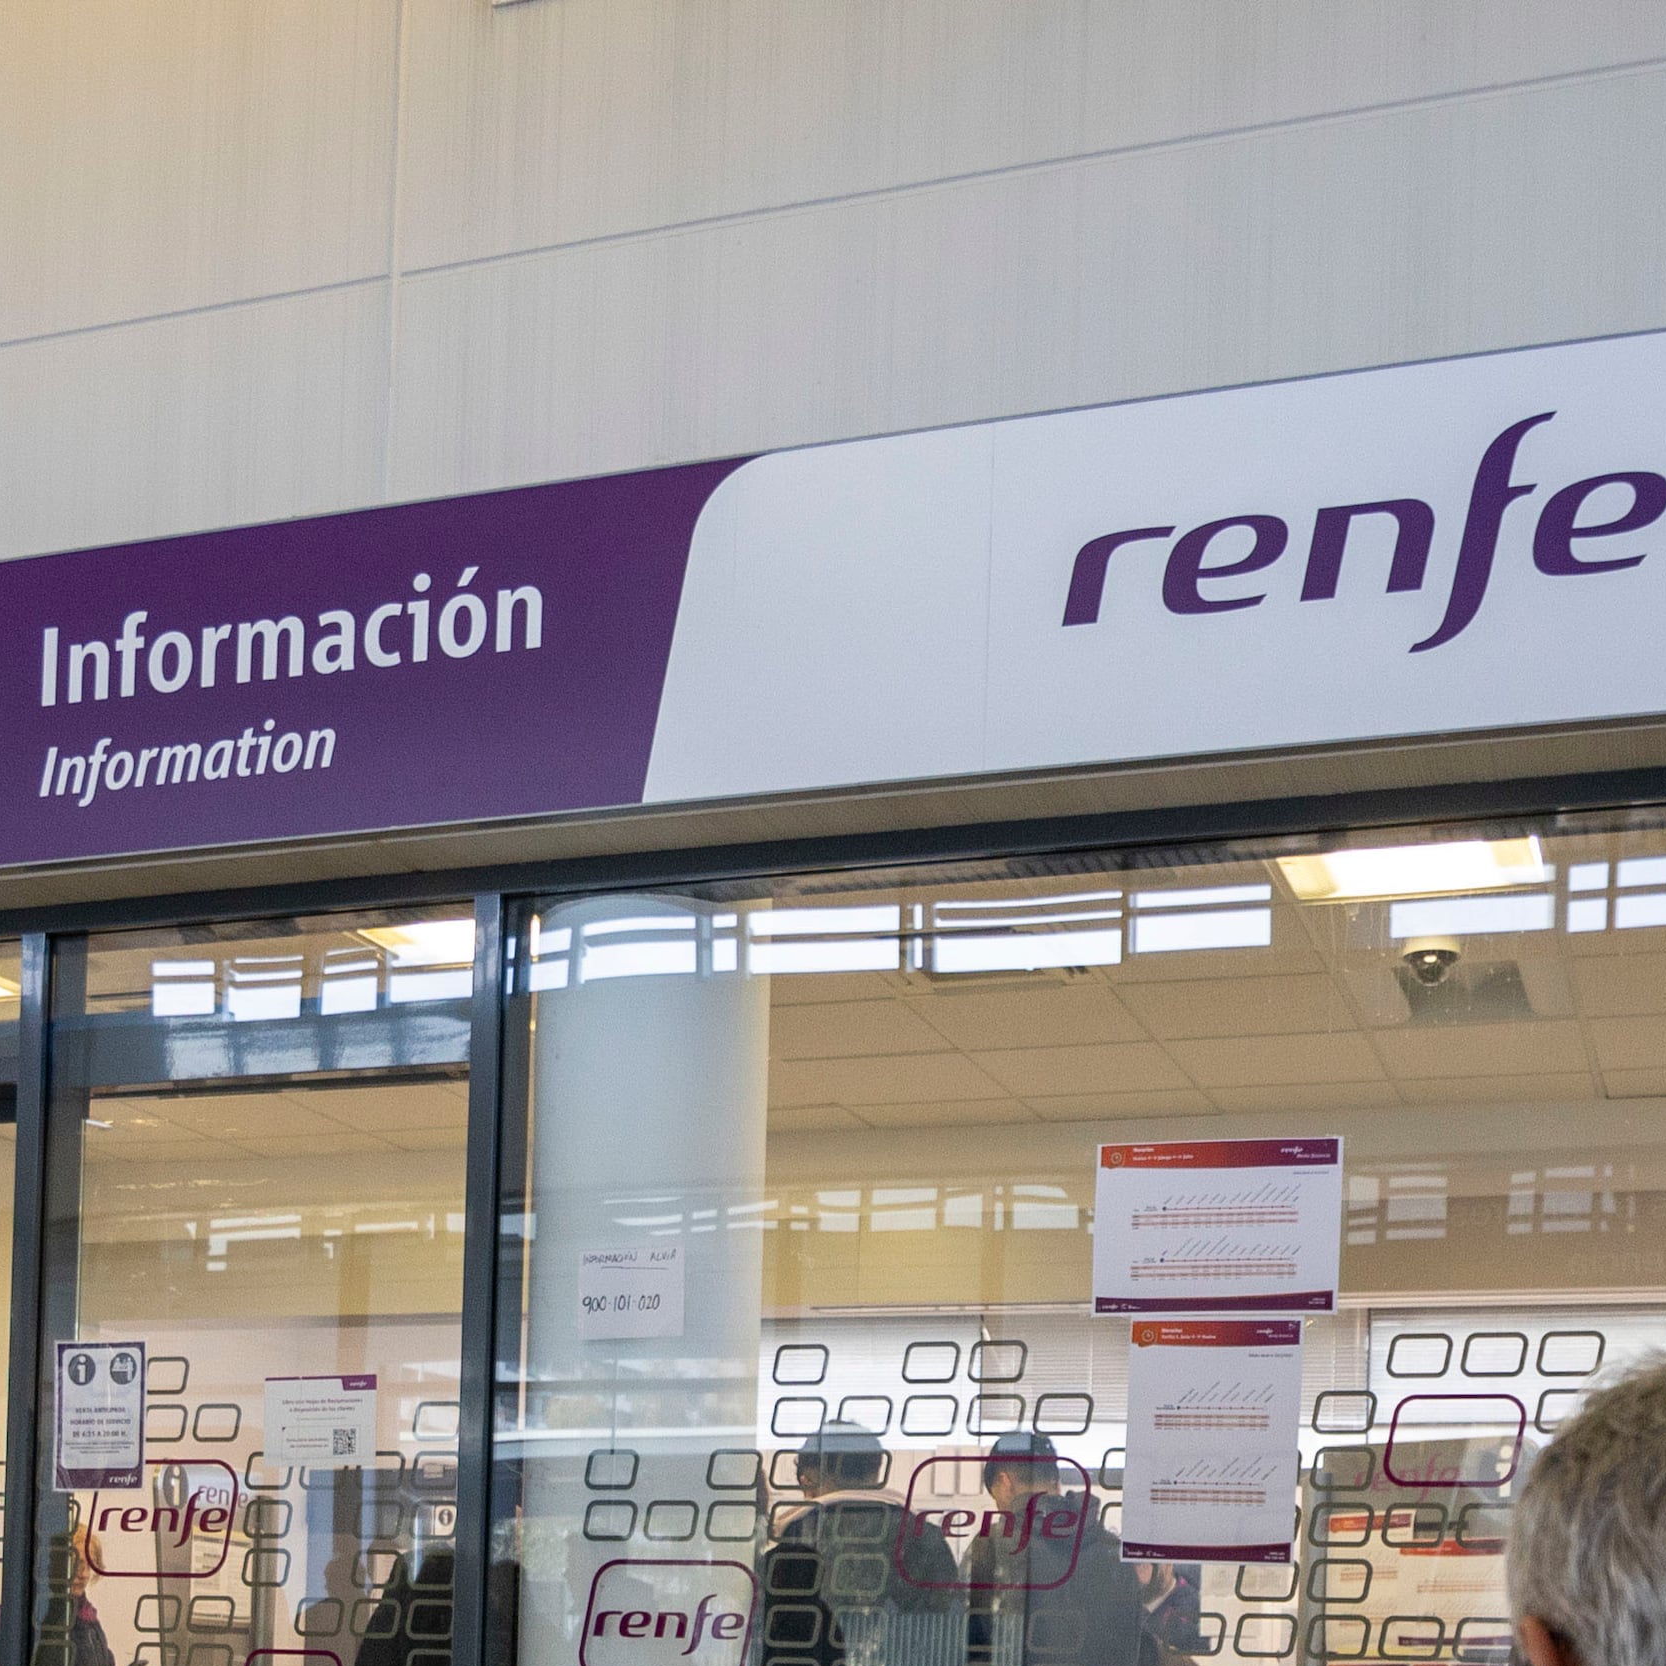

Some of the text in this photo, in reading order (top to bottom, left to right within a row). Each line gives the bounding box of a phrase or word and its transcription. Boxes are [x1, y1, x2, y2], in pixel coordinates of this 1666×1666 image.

[41, 567, 544, 707] Información
[38, 719, 337, 808] Information
[108, 1473, 138, 1486] renfe
[98, 1491, 228, 1548] renfe
[913, 1491, 1079, 1556] renfe
[592, 1594, 745, 1656] renfe
